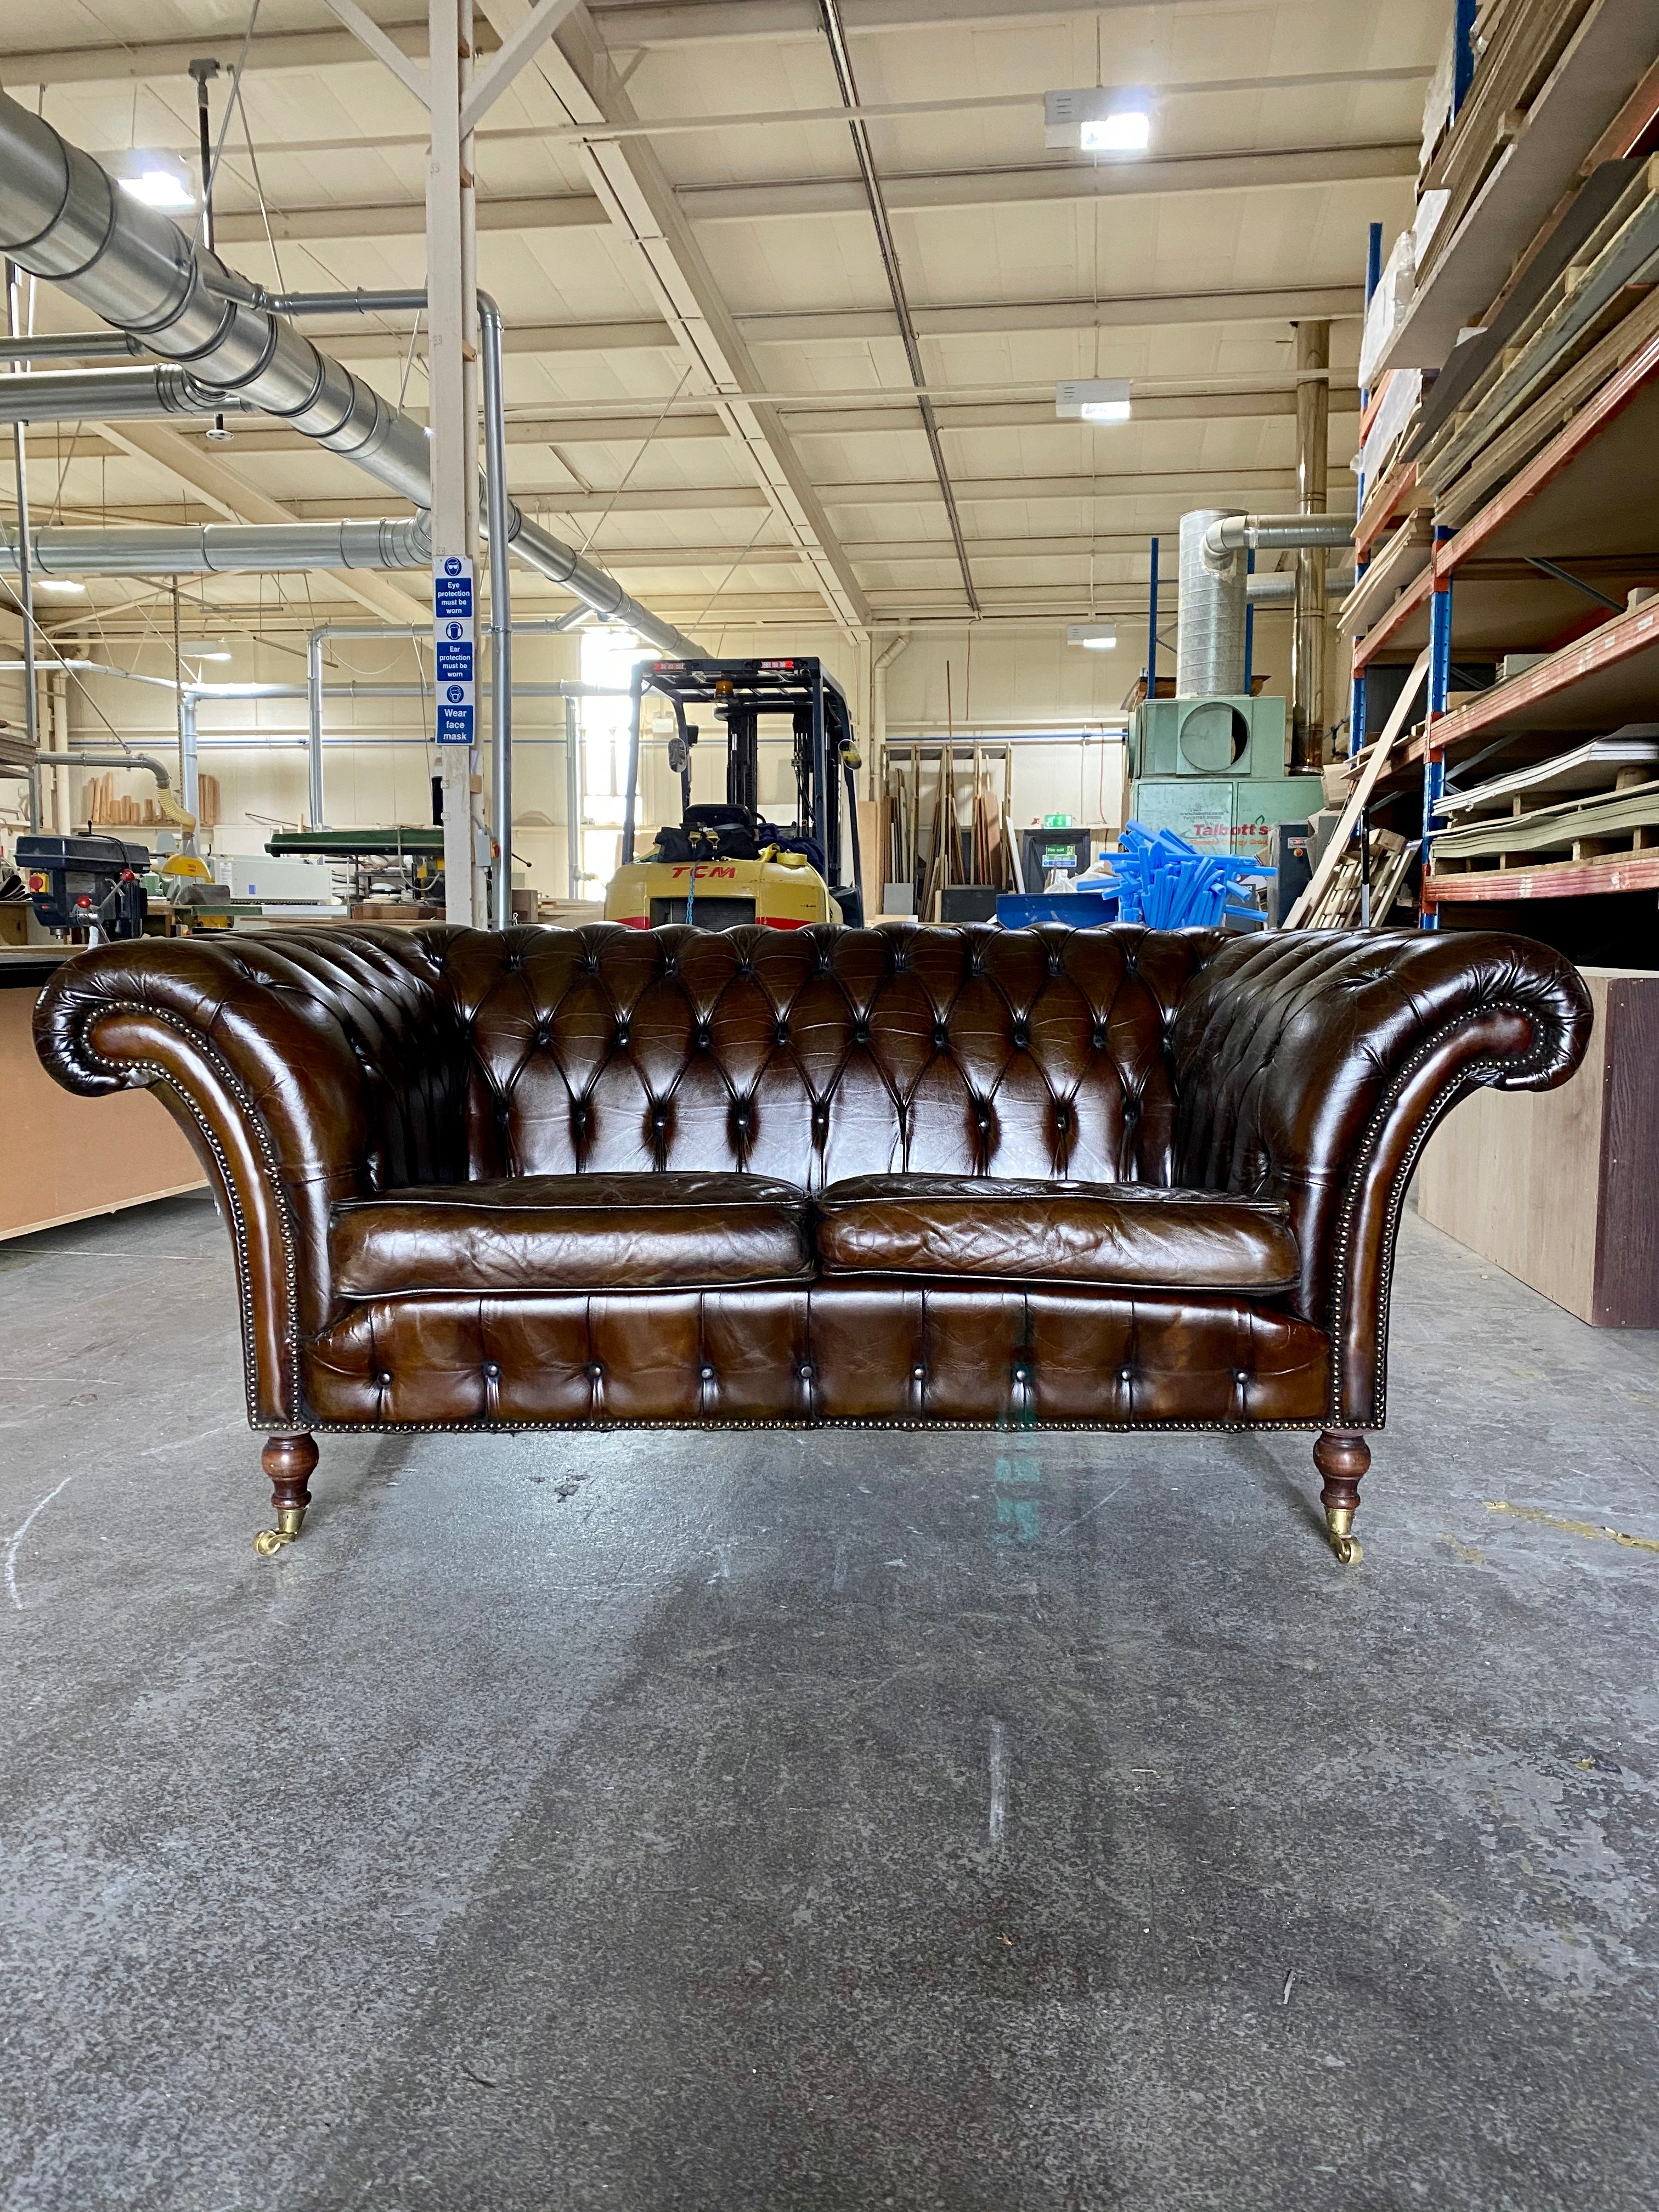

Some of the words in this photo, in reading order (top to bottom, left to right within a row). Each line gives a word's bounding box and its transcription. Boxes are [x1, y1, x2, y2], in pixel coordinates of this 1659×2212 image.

[437, 590, 470, 599] protection
[439, 654, 471, 662] protection
[444, 708, 467, 717] Wear
[446, 720, 465, 729] face
[443, 732, 467, 740] mask
[672, 866, 736, 878] TCM
